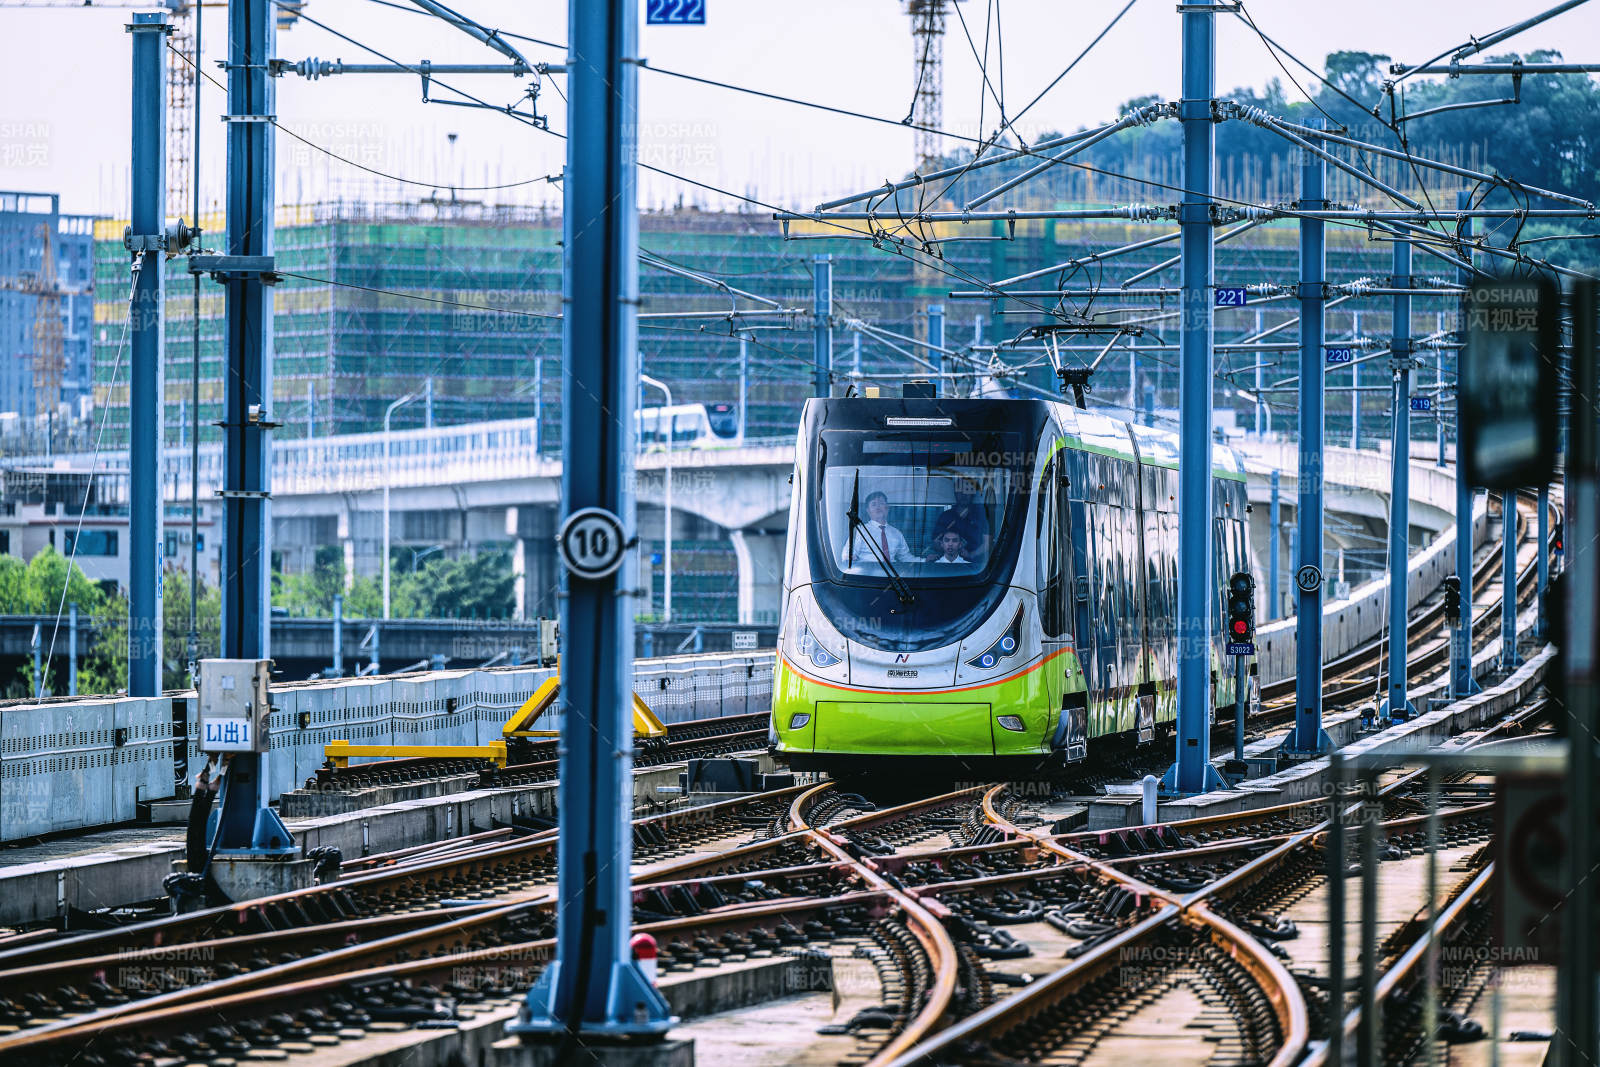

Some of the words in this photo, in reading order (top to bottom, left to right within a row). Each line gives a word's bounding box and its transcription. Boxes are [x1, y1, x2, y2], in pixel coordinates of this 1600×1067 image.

[650, 0, 702, 21] 222
[1218, 290, 1244, 305] 221
[1328, 350, 1350, 361] 220
[1412, 399, 1430, 409] 219
[575, 527, 609, 559] 10
[1302, 571, 1316, 585] 10
[1230, 646, 1251, 654] S3022
